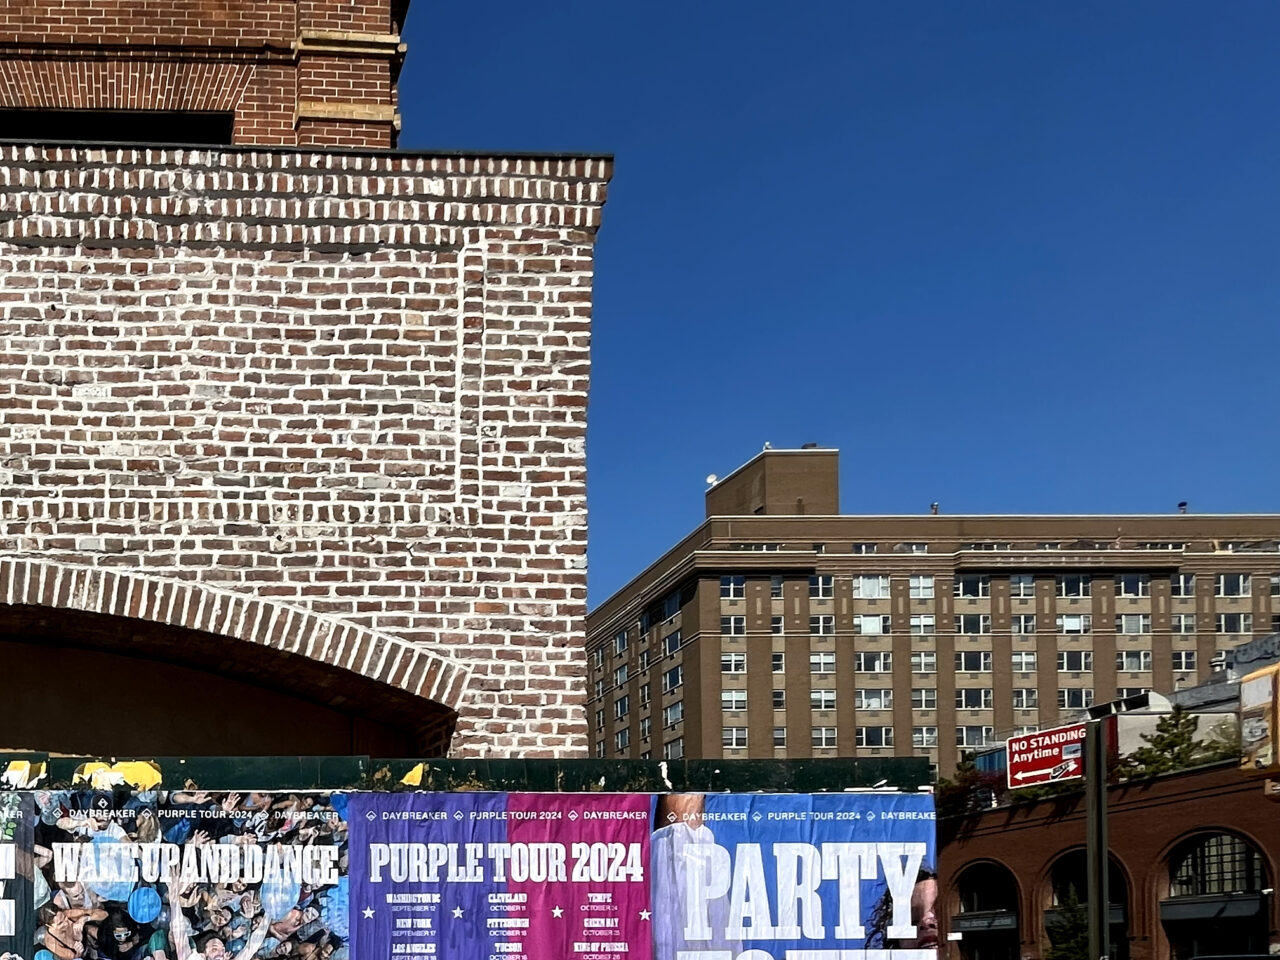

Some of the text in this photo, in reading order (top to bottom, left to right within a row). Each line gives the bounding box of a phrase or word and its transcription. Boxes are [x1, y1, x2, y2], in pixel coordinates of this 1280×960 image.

[1012, 728, 1086, 752] NO STANDING
[1013, 747, 1060, 763] Anytime
[70, 809, 339, 820] DAYBREAKER PURPLE TOUR 2024 DAYBREAKER
[382, 811, 447, 820] DAYBREAKER
[510, 811, 537, 820] TOUR
[539, 811, 562, 820] 2024
[584, 811, 647, 820] DAYBREAKER
[683, 812, 747, 821] DAYBREAKER
[768, 812, 806, 821] PURPLE
[809, 812, 835, 821] TOUR
[836, 811, 860, 820] 2024
[52, 842, 339, 885] WAKE UP AND DANCE
[370, 842, 644, 883] PURPLE TOUR 2024
[683, 842, 926, 941] PARTY
